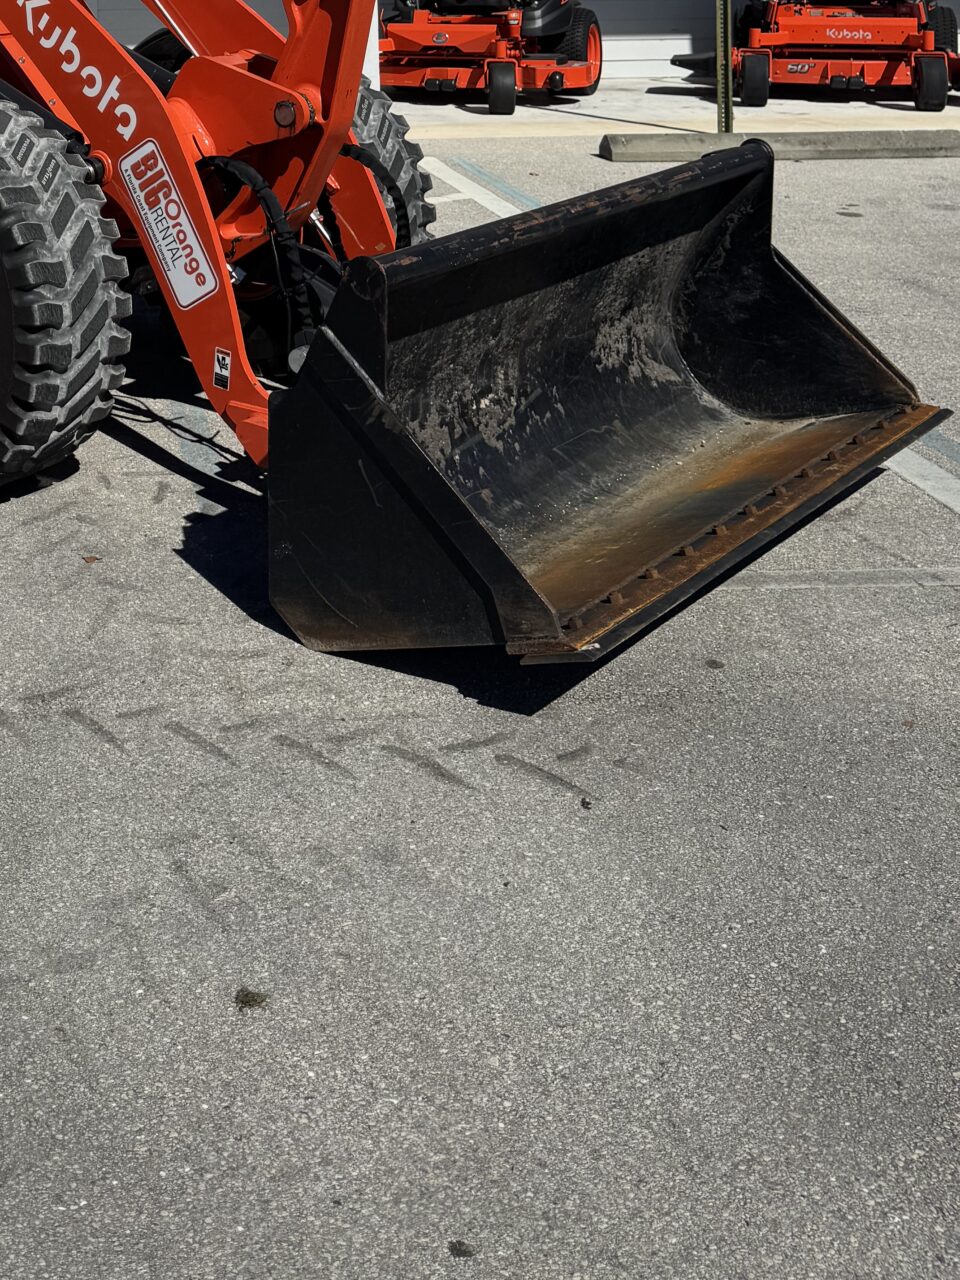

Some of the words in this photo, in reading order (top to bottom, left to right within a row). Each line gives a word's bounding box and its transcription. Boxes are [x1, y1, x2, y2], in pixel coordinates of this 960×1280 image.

[826, 28, 872, 40] Kubota
[126, 173, 138, 195] Florida
[143, 212, 160, 246] Equipment
[157, 243, 171, 271] Company
[130, 149, 173, 211] BIG
[164, 198, 207, 288] Orange
[151, 206, 183, 269] RENTAL
